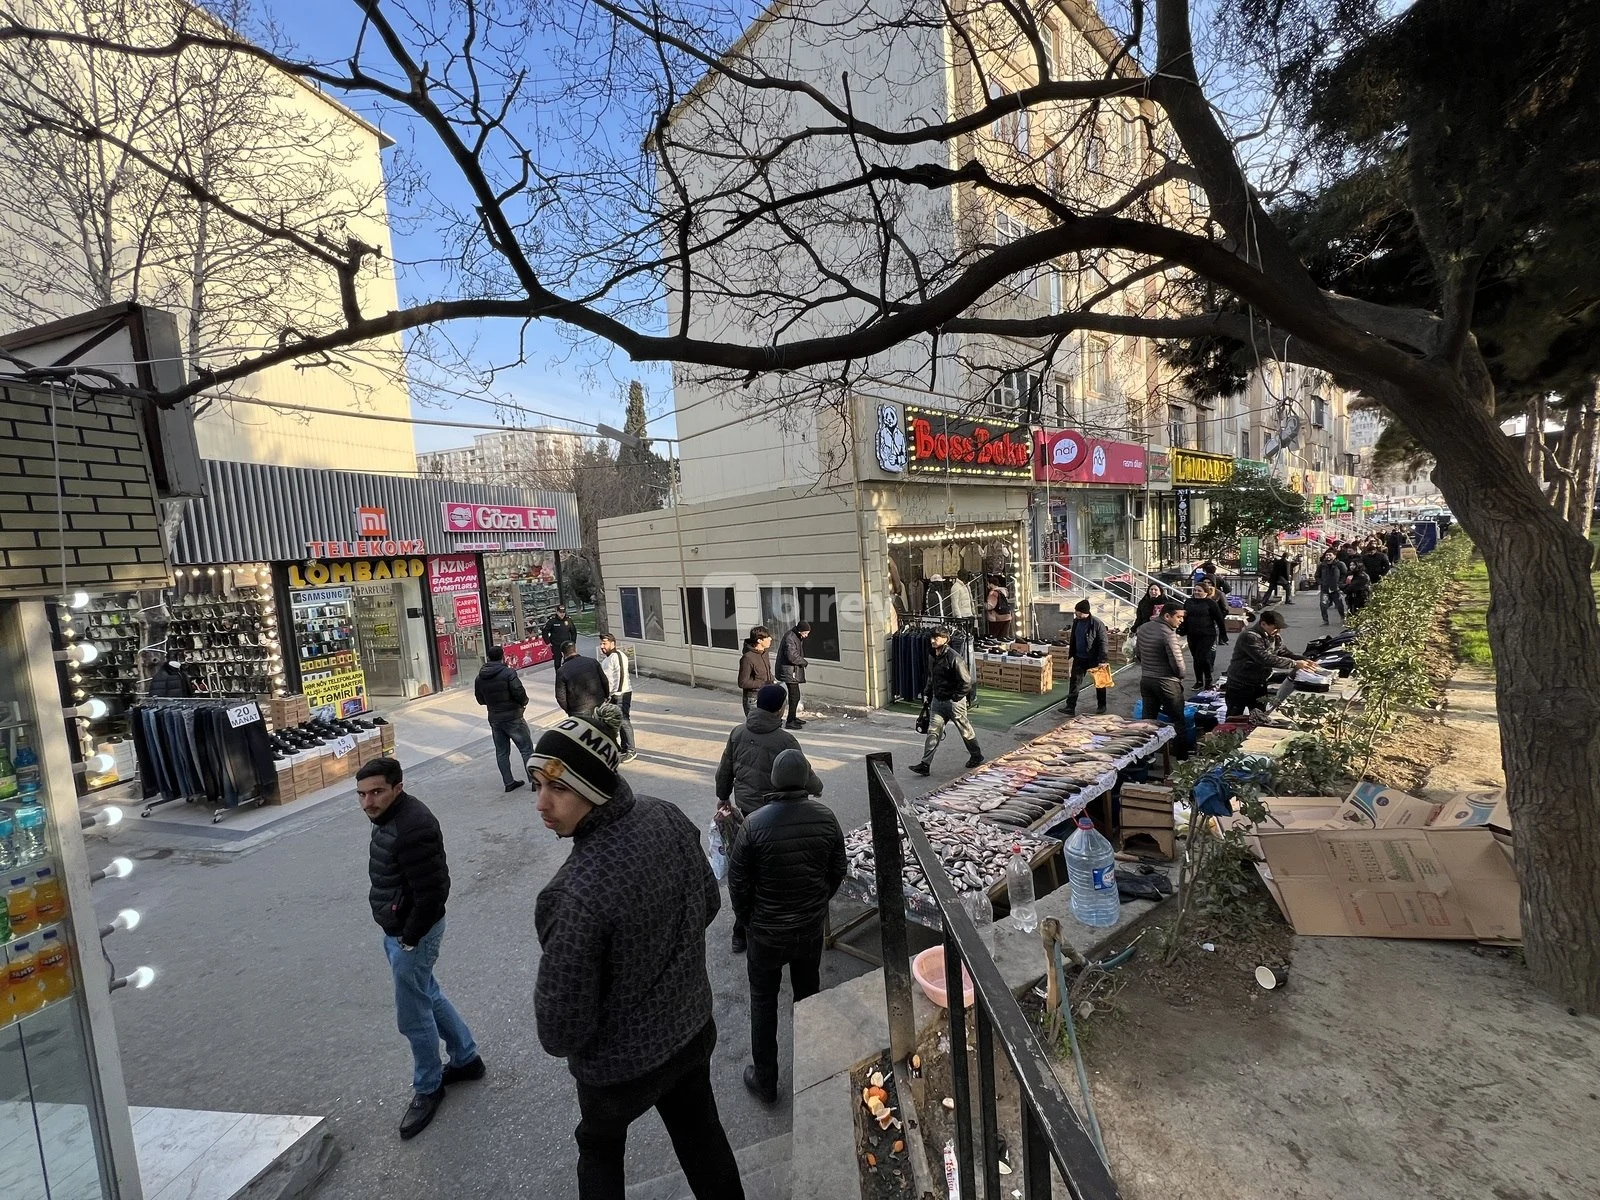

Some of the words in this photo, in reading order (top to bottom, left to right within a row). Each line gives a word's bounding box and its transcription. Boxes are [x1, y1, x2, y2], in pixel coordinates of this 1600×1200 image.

[912, 418, 975, 462] Boss
[1055, 446, 1076, 456] nar
[288, 558, 425, 588] LOMBARD
[432, 575, 478, 585] BAŞLAYAN
[301, 590, 343, 602] SAMSUNG
[319, 686, 354, 704] TƏMİRİ
[235, 706, 250, 718] 20
[231, 713, 259, 727] MANAT
[338, 744, 352, 755] AZN
